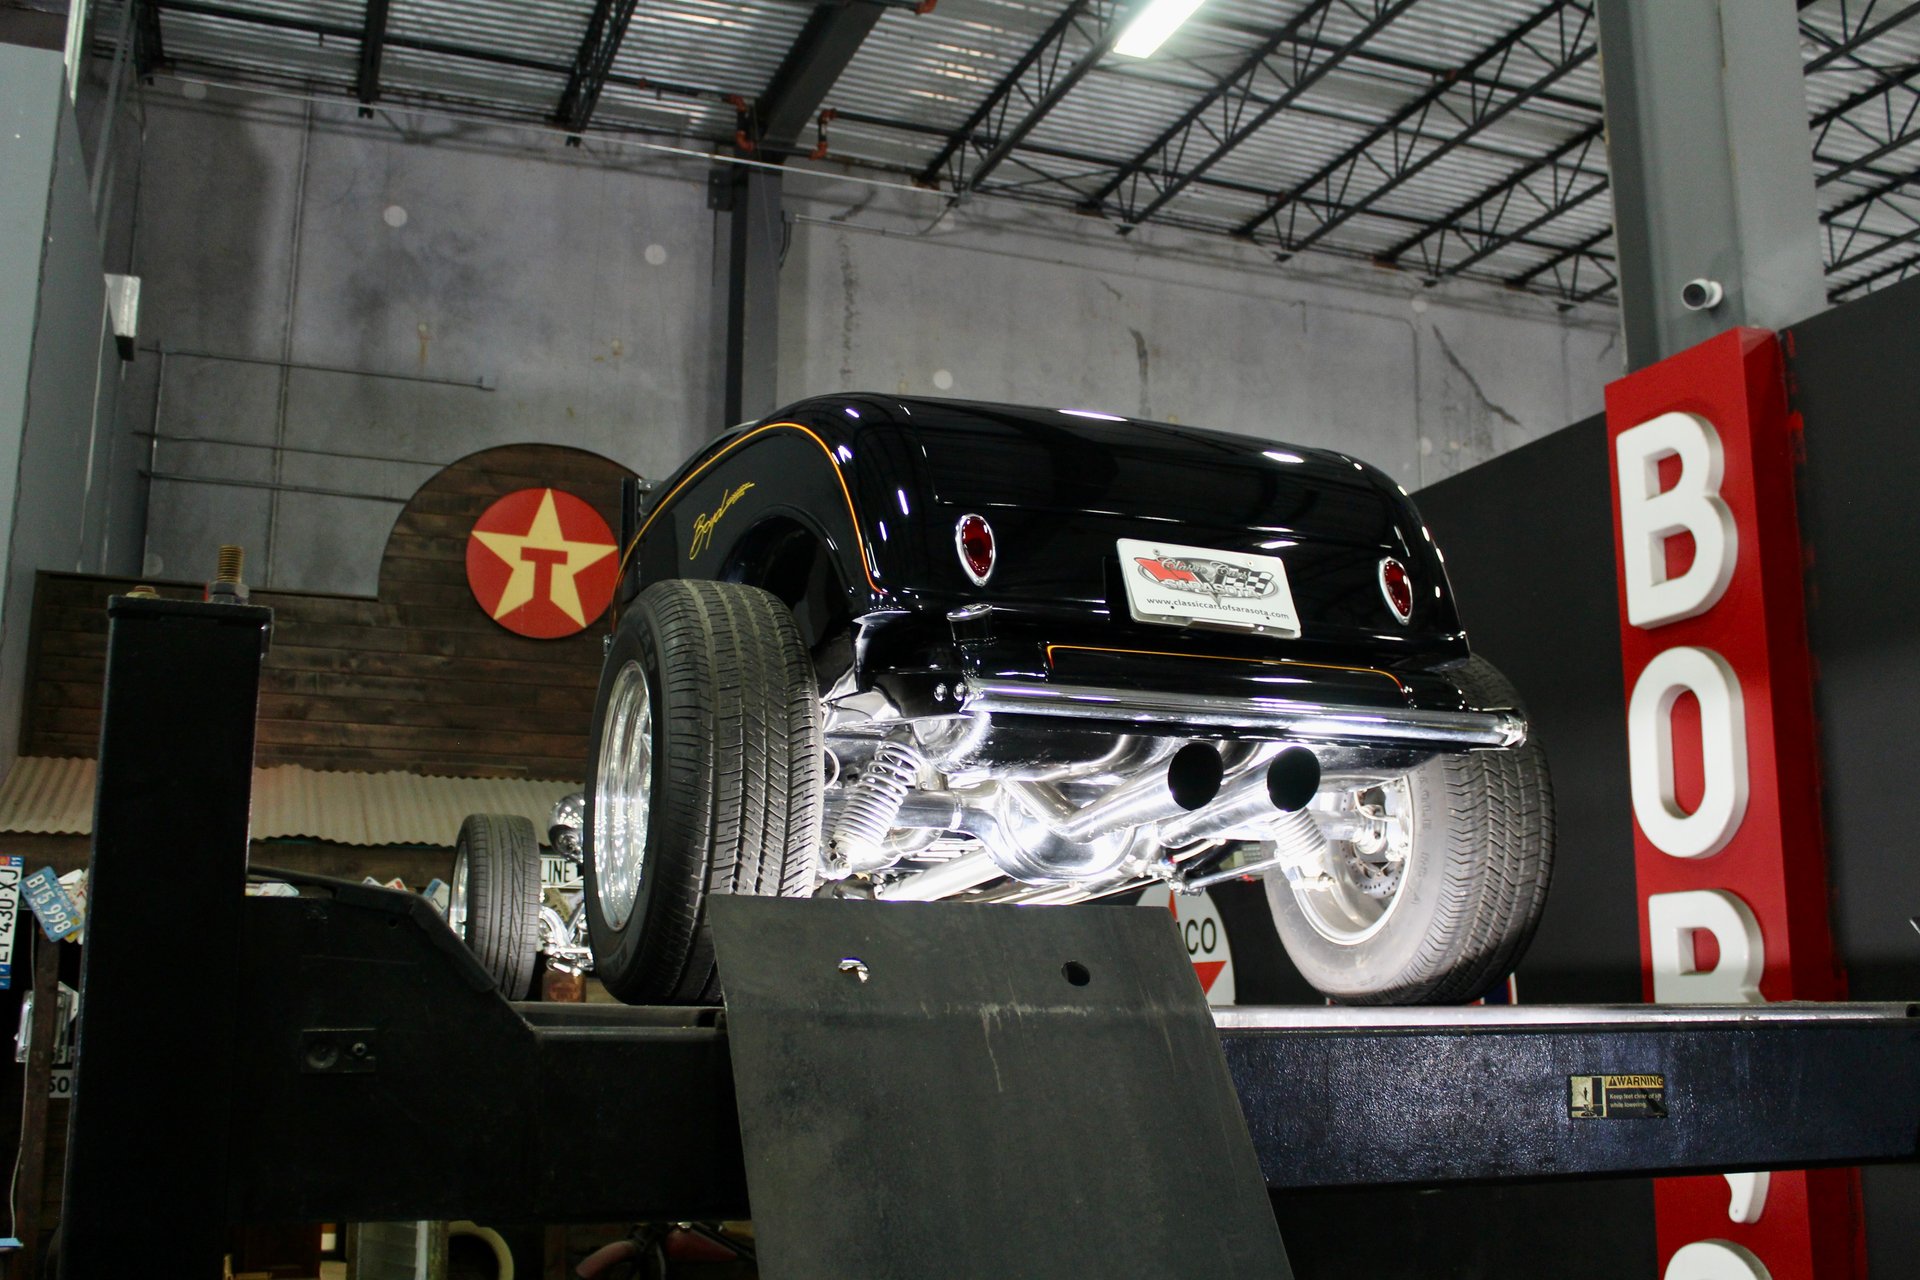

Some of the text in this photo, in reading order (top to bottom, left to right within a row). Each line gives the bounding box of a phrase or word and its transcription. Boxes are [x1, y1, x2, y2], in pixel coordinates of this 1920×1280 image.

[1160, 579, 1262, 600] SARASOTA
[1147, 597, 1290, 619] www.classiccarsofsarasota.com
[26, 874, 72, 933] BT5 998
[1177, 916, 1217, 955] CO
[1616, 1076, 1664, 1086] WARNING
[1609, 1093, 1623, 1101] Keep
